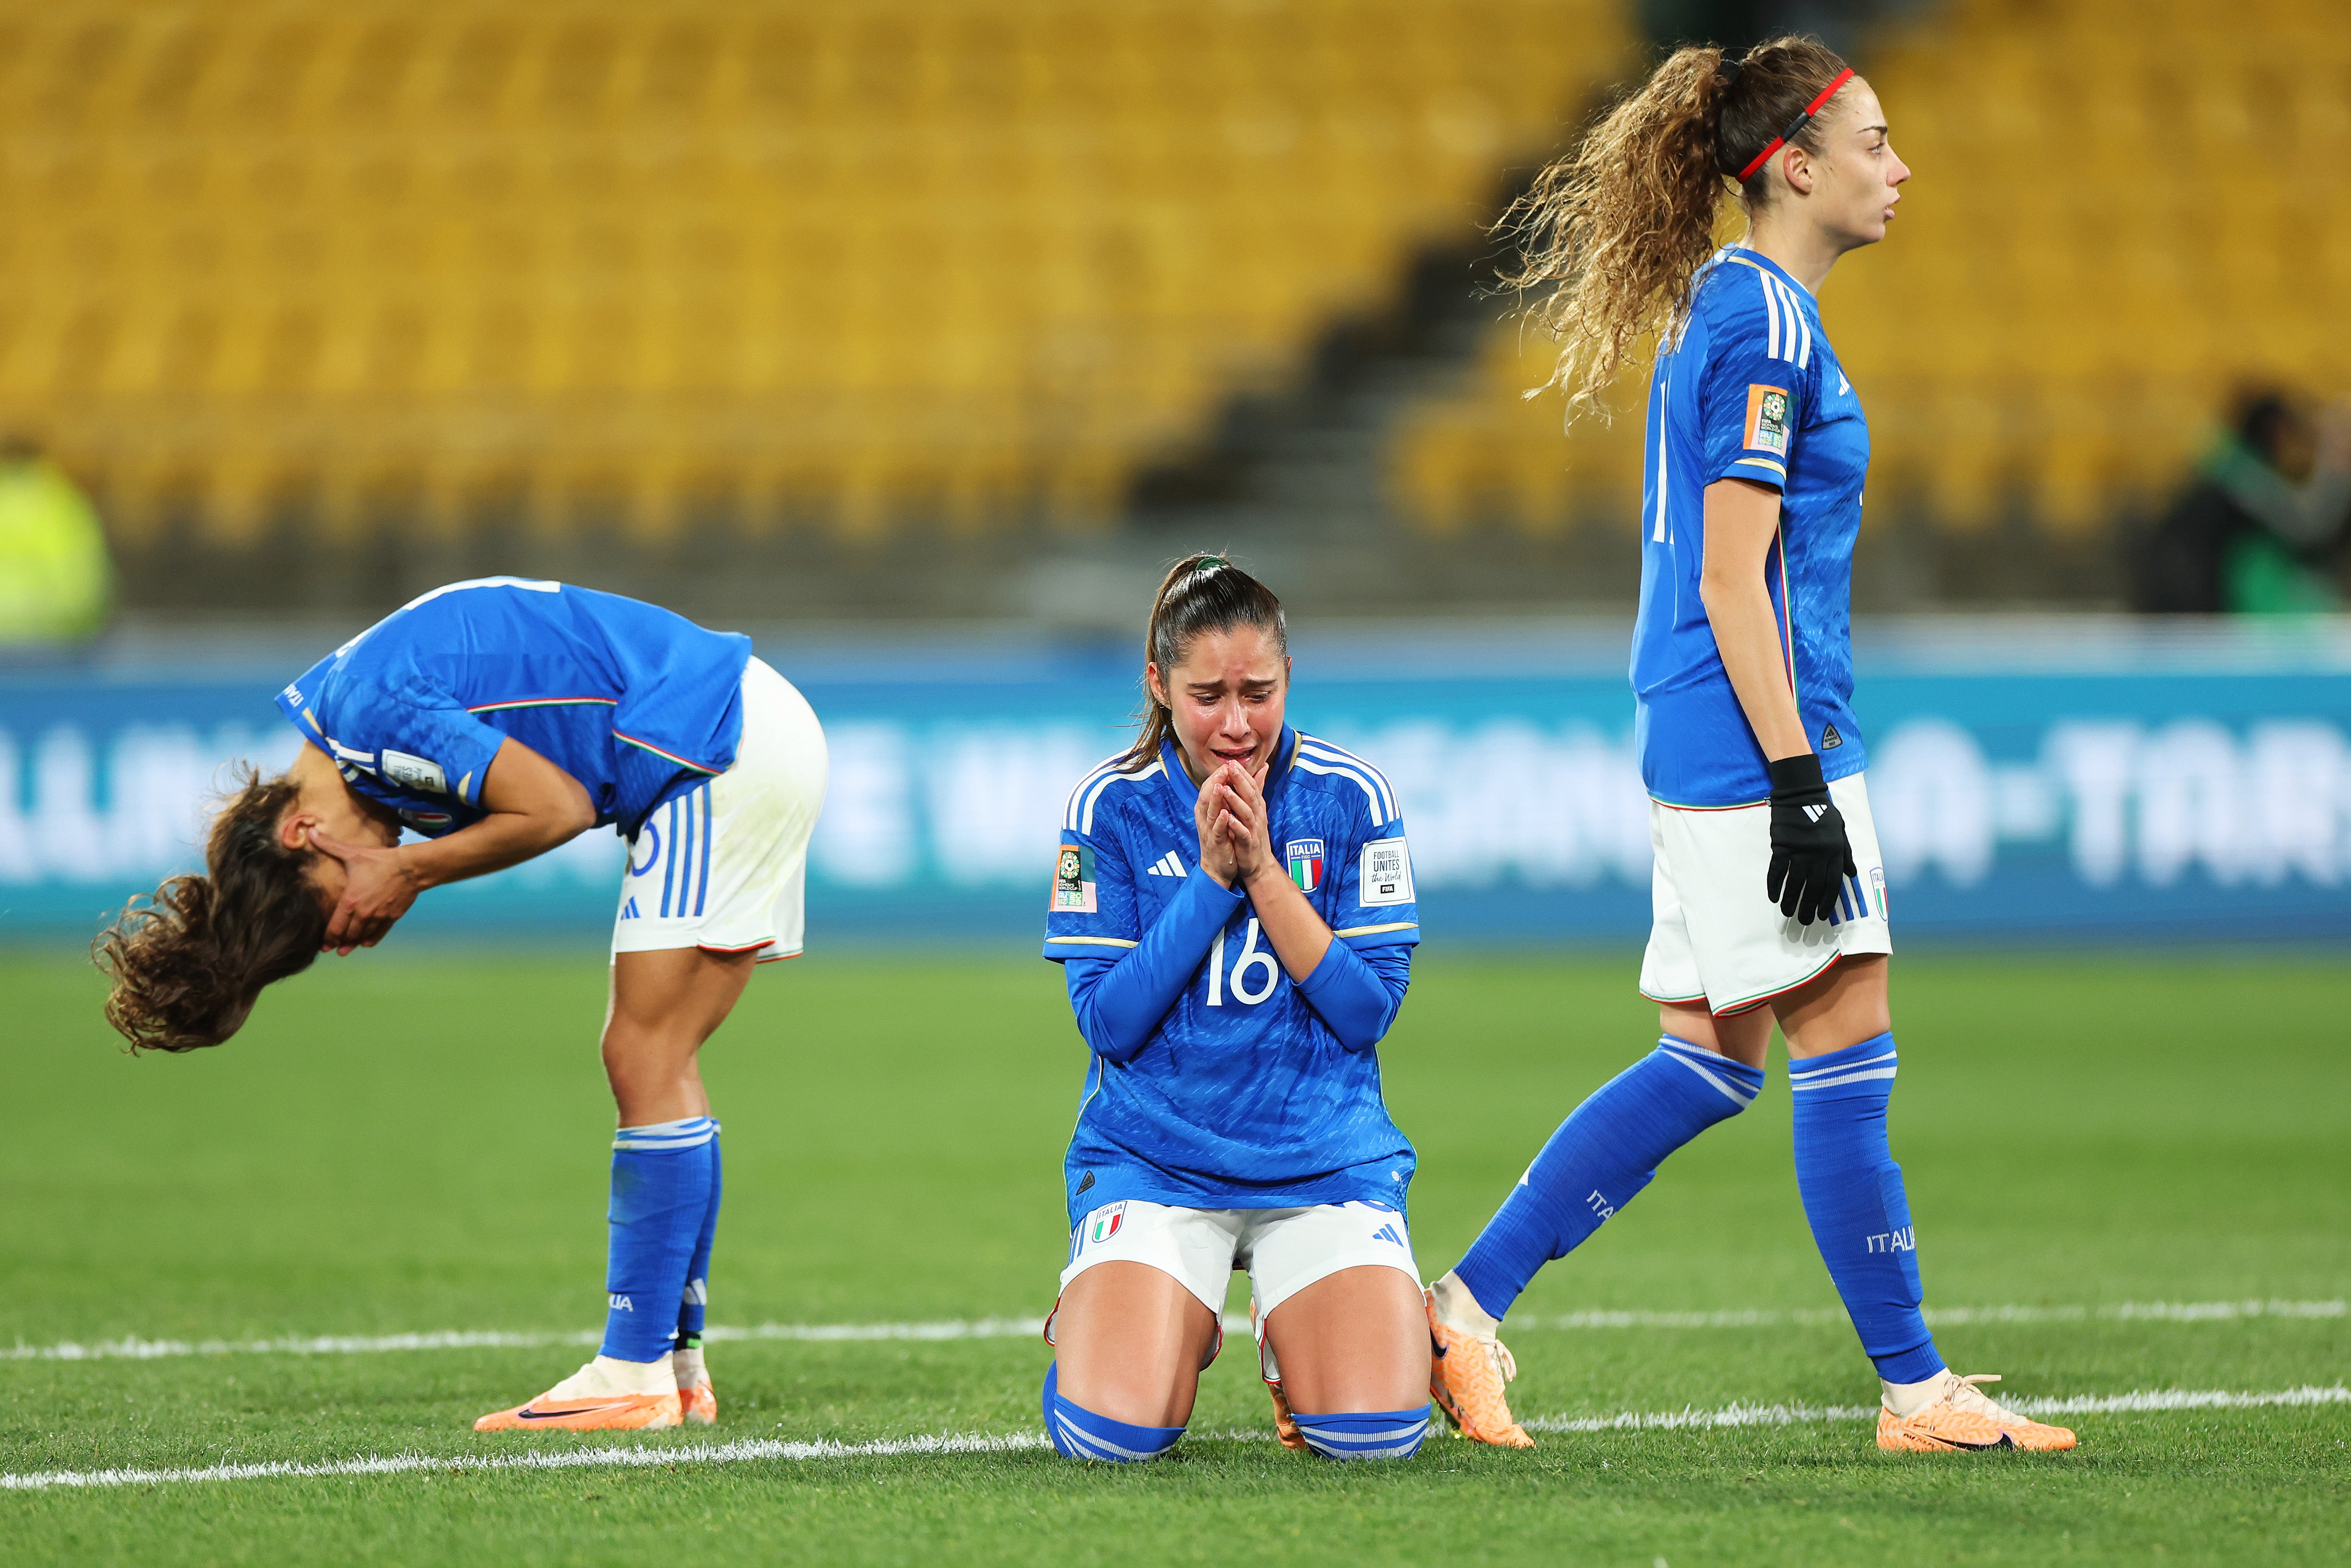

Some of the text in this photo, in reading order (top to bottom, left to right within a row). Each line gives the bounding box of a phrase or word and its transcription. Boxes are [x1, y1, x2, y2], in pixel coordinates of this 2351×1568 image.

[1290, 843, 1321, 856] ITALIA
[1374, 849, 1399, 860] FOOTBALL
[1374, 859, 1400, 872] UNITES
[1371, 871, 1401, 882] the World
[1206, 917, 1279, 1006] 16
[1098, 1204, 1122, 1219] ITALIA
[1586, 1189, 1616, 1224] ITA
